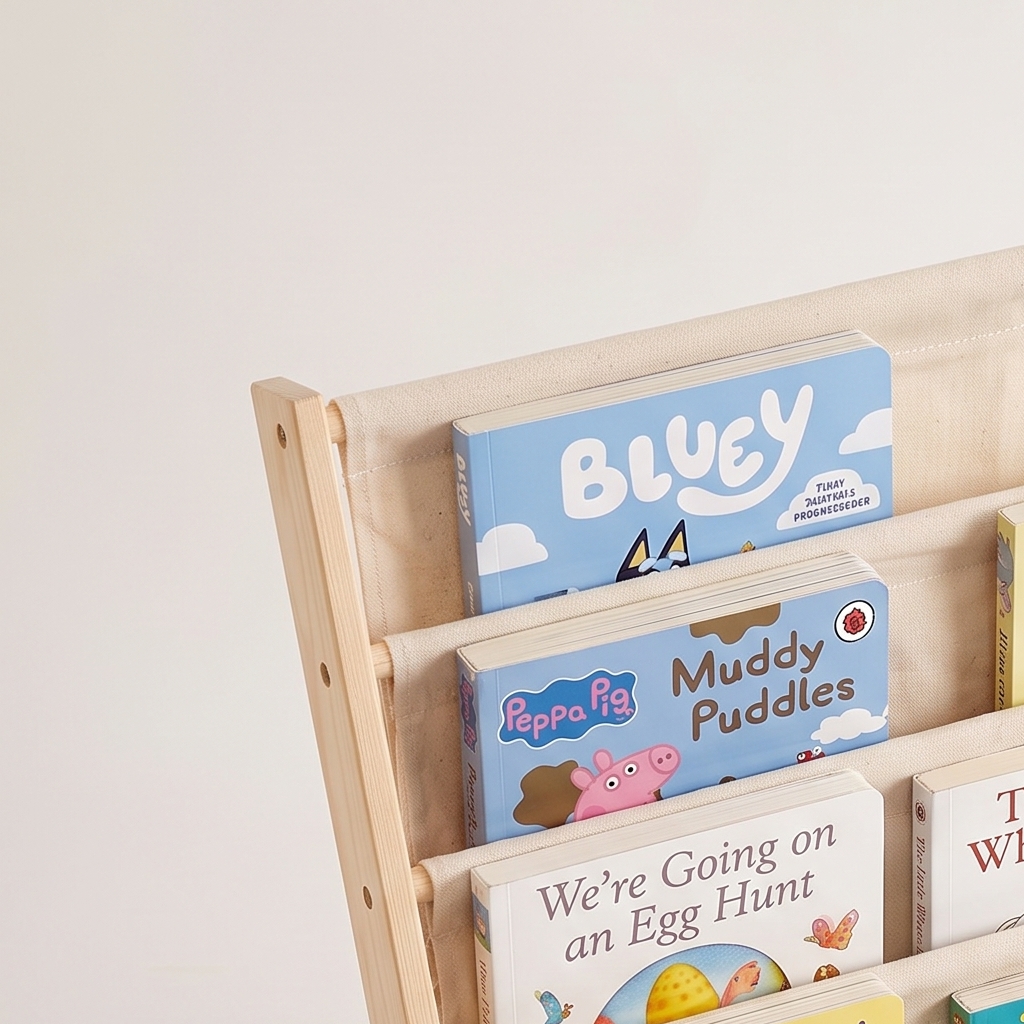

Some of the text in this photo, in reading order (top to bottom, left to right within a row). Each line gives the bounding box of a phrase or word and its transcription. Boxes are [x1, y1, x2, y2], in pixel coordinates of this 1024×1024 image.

[561, 385, 814, 518] BLUEY
[671, 630, 825, 697] Muddy
[506, 697, 587, 740] Peppa
[590, 677, 634, 717] Pig
[691, 677, 856, 742] Puddles
[661, 837, 780, 889] Going
[791, 823, 838, 856] on
[565, 869, 815, 963] an Egg Hunt
